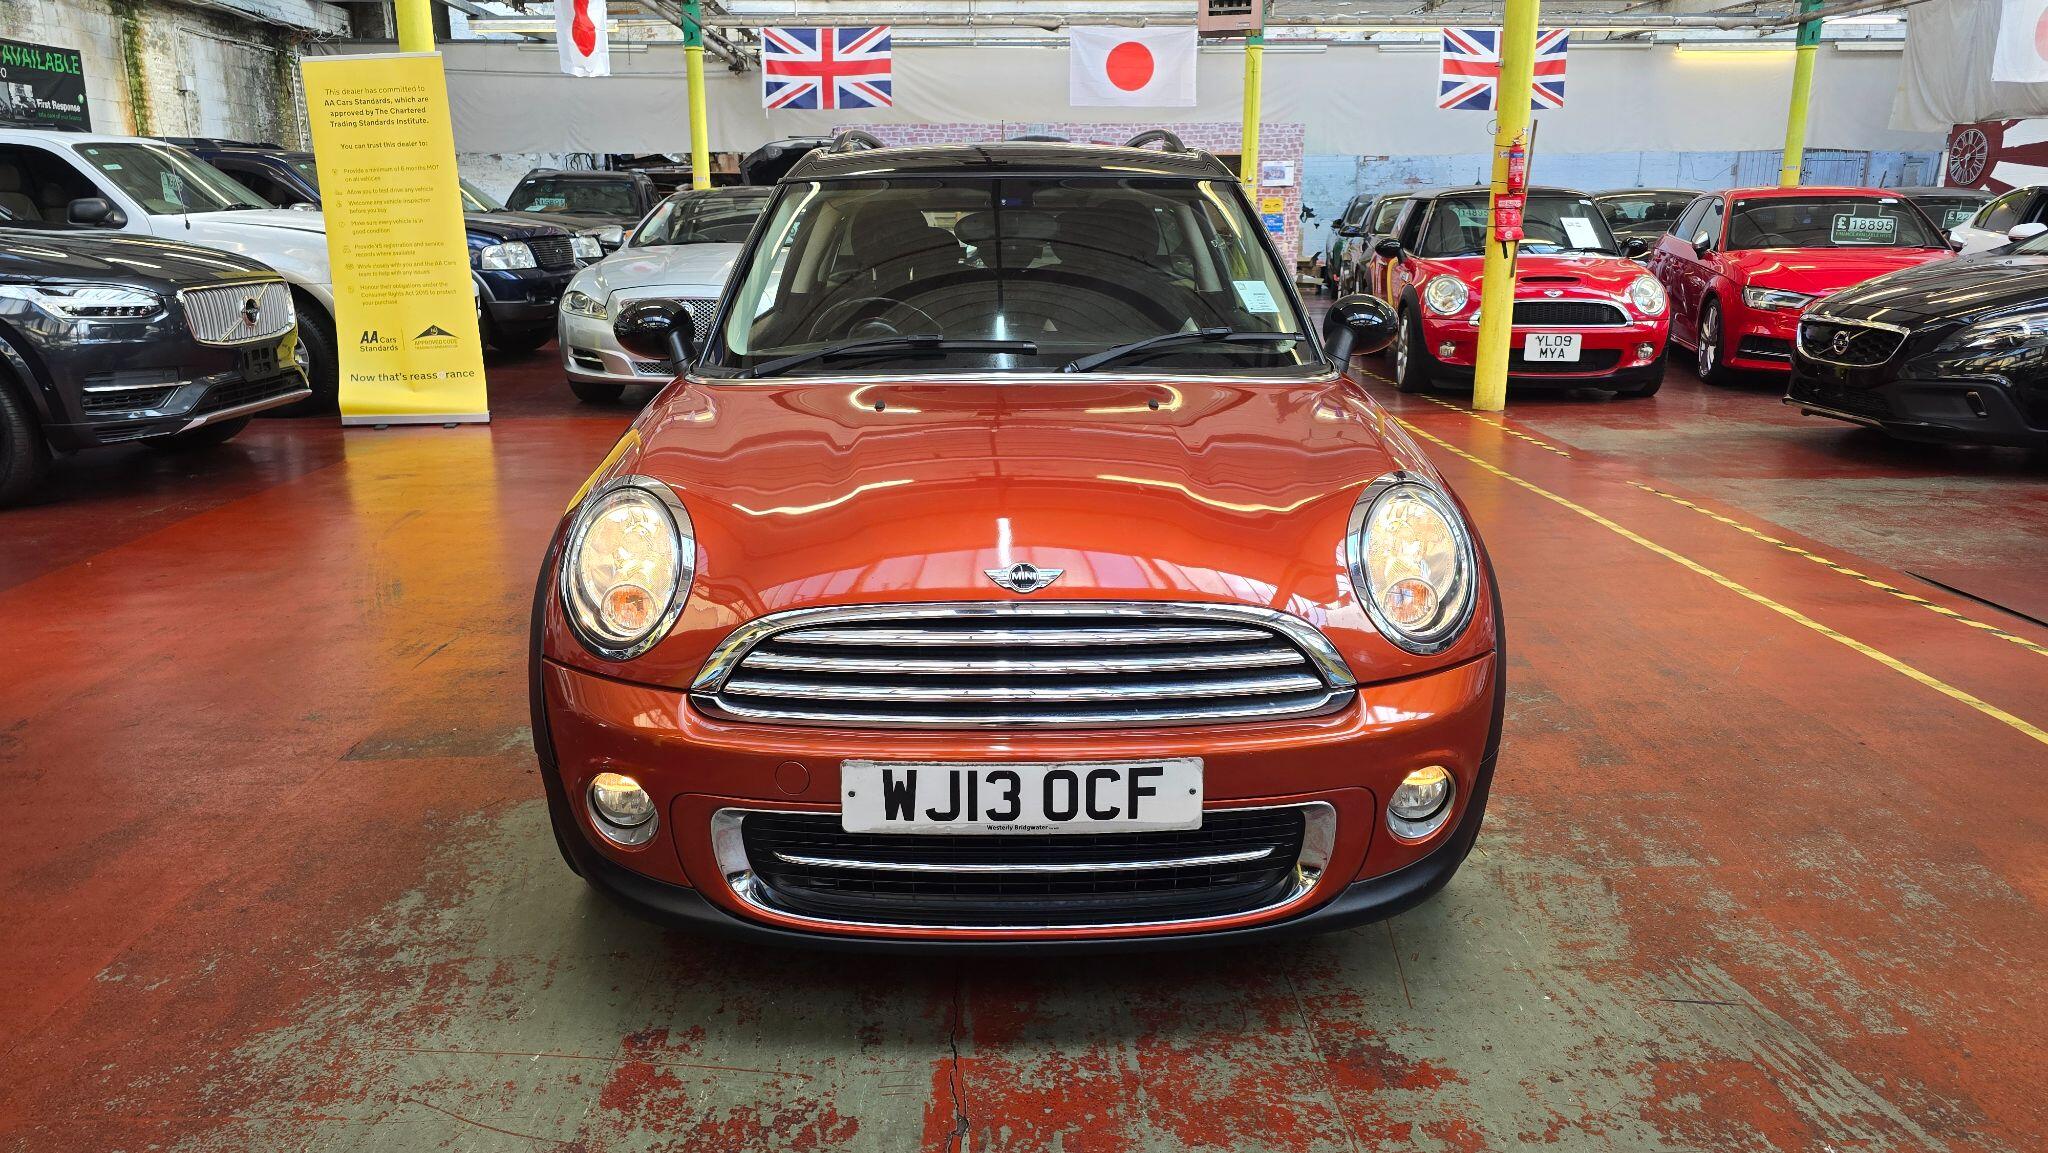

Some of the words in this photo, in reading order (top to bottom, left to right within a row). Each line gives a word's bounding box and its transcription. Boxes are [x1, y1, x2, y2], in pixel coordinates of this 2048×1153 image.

[2, 45, 80, 74] AVAILABLE
[36, 98, 51, 109] First
[52, 100, 80, 112] Response
[330, 110, 364, 118] approved
[366, 109, 374, 117] by
[330, 120, 357, 128] Trading
[360, 331, 379, 344] AA
[1537, 336, 1572, 346] YL09
[1540, 348, 1565, 358] MYA
[351, 374, 375, 382] Now
[378, 373, 407, 381] that's
[1012, 572, 1036, 580] MINI
[882, 769, 1021, 822] WJ13
[1043, 766, 1163, 822] OCF
